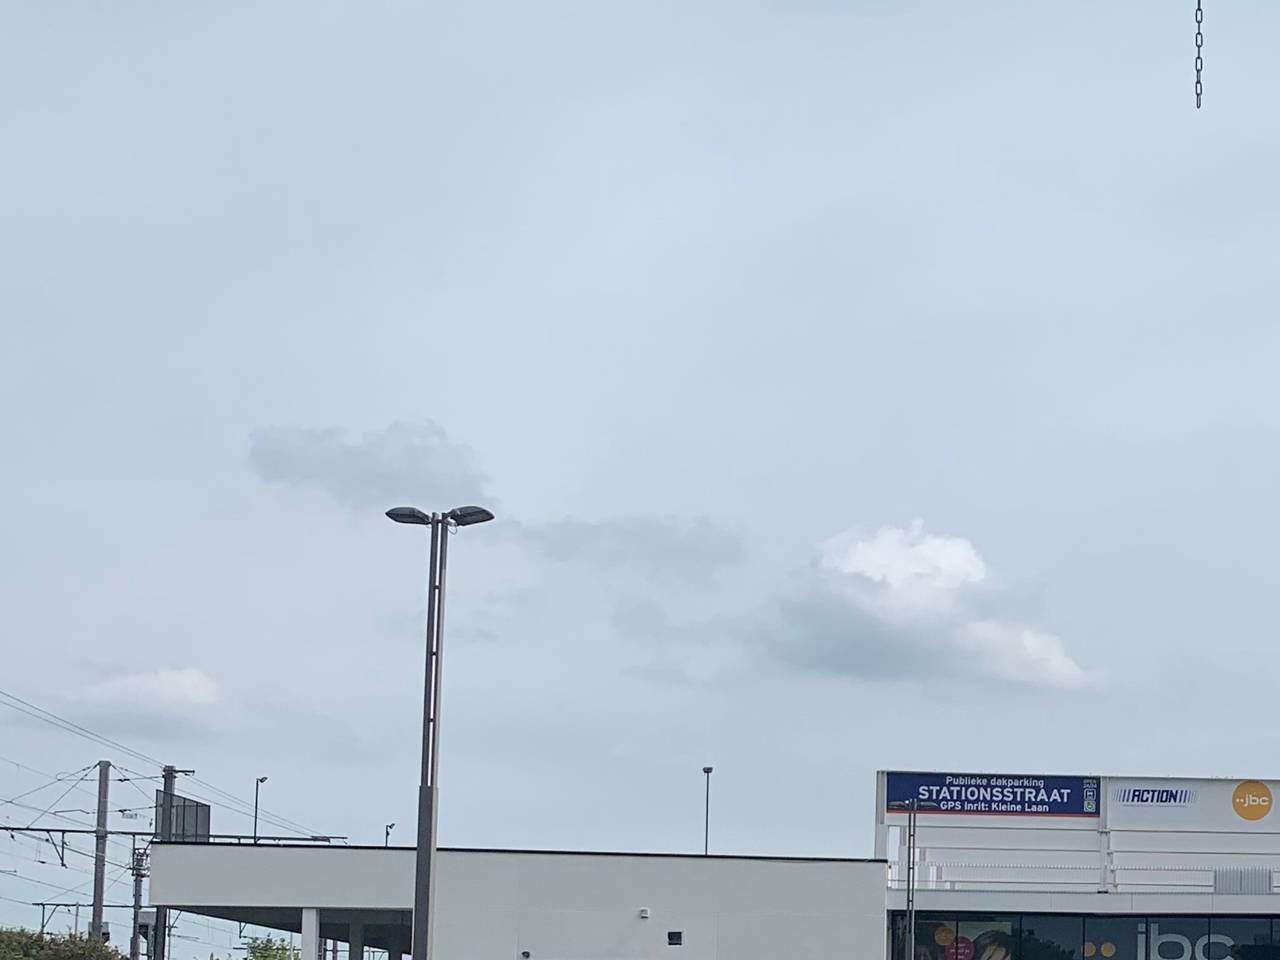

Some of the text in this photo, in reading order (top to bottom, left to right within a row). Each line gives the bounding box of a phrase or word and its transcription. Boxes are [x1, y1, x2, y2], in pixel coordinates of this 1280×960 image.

[946, 776, 1044, 788] Publieke dakparking
[918, 786, 1071, 803] STATIONSSTRAAT
[1131, 788, 1179, 804] ACTION
[1243, 793, 1270, 807] jbc
[940, 801, 962, 810] GPS
[991, 802, 1022, 812] Kleine
[1025, 803, 1049, 813] Laan
